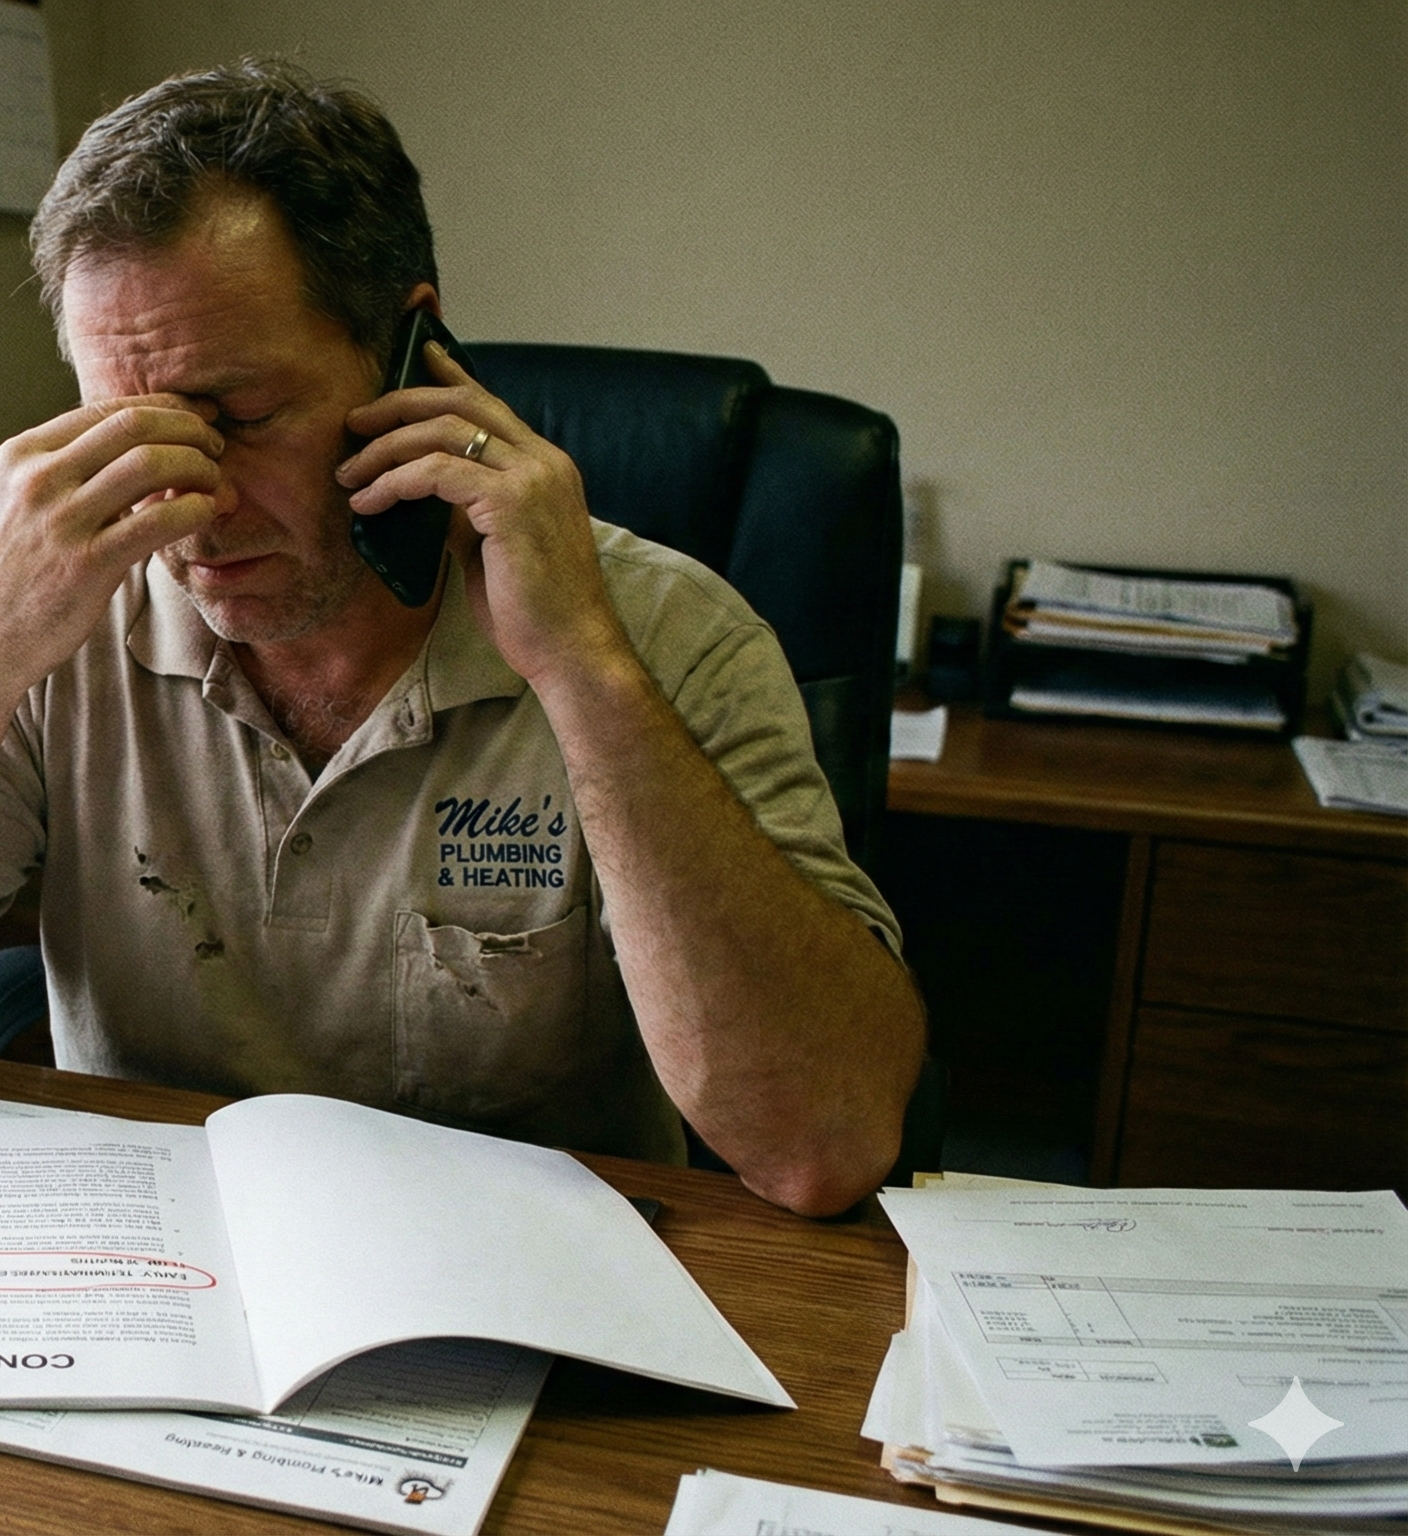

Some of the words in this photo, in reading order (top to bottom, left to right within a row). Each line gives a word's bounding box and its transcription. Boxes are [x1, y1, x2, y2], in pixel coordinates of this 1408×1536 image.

[434, 795, 567, 838] Mike's
[440, 843, 562, 864] PLUMBING
[437, 868, 454, 887] &
[463, 868, 565, 888] HEATING
